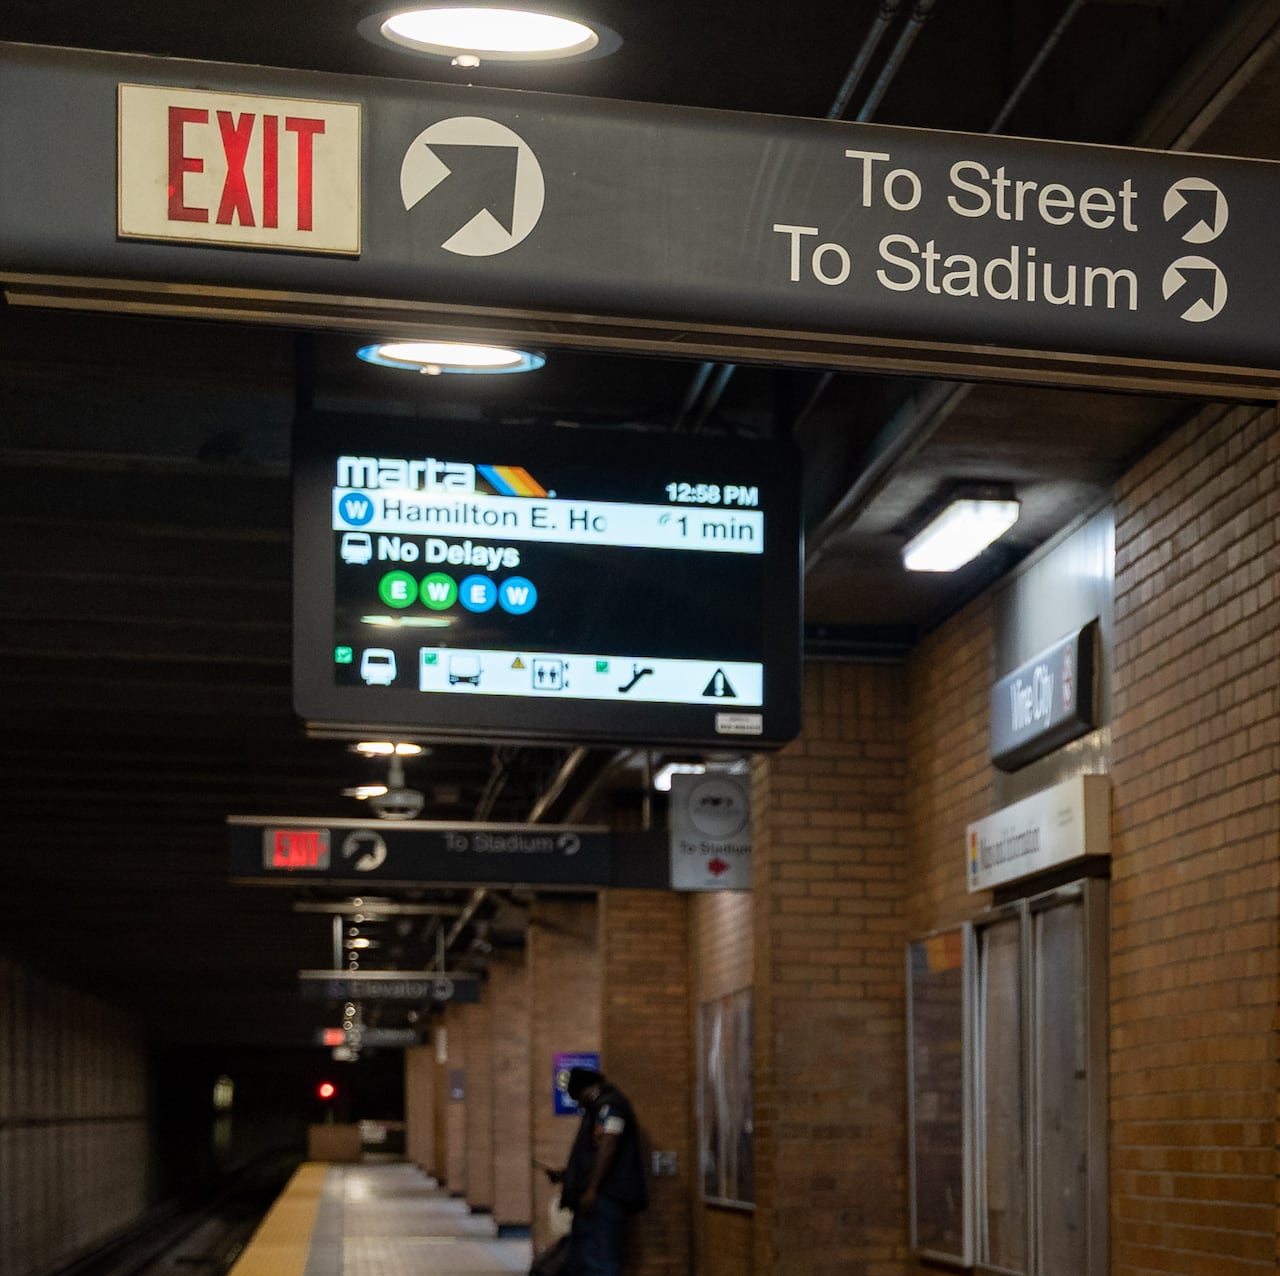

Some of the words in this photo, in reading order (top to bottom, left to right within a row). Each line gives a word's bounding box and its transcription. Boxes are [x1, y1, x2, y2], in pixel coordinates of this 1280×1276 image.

[168, 109, 324, 230] EXIT
[846, 150, 921, 210] To
[948, 161, 1137, 231] Street
[774, 224, 850, 285] To
[877, 234, 1137, 310] Stadium
[337, 457, 476, 492] marta
[724, 486, 758, 506] PM
[383, 499, 518, 528] Hamilton
[530, 508, 557, 529] E.
[701, 517, 754, 542] min
[378, 536, 419, 563] No
[425, 539, 521, 571] Delays
[391, 580, 407, 600] E
[427, 582, 449, 602] W
[470, 585, 487, 604] E
[506, 588, 529, 607] W
